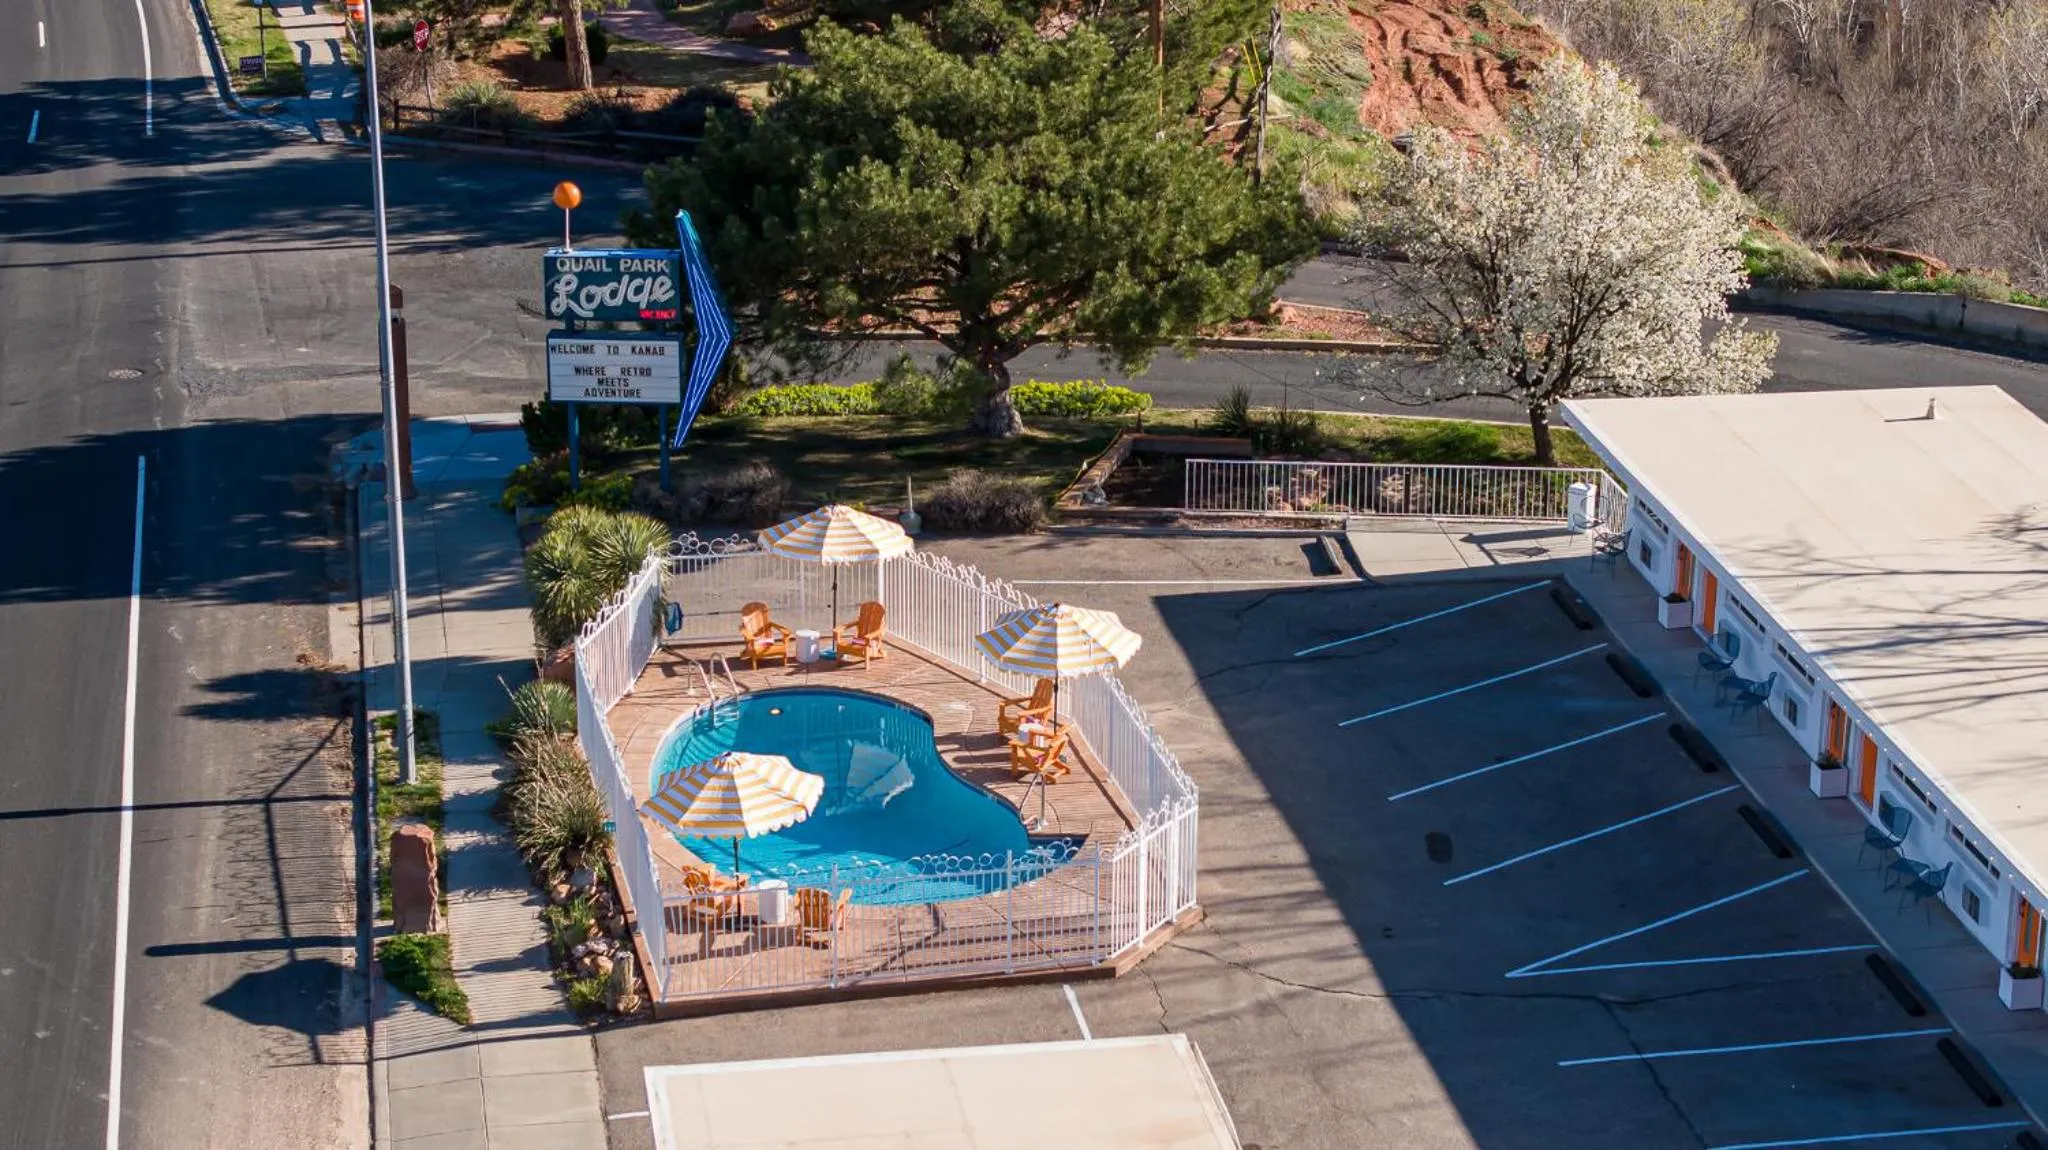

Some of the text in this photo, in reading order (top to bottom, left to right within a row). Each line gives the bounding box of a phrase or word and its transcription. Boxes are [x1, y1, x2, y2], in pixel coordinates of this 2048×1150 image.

[557, 258, 670, 273] QUAIL PARK
[550, 274, 676, 317] Lodge
[550, 345, 665, 356] WELCOME TO KANAB
[574, 366, 652, 377] WHERE RETRO
[597, 378, 629, 387] MEETS
[583, 388, 641, 398] ADVENTURE
